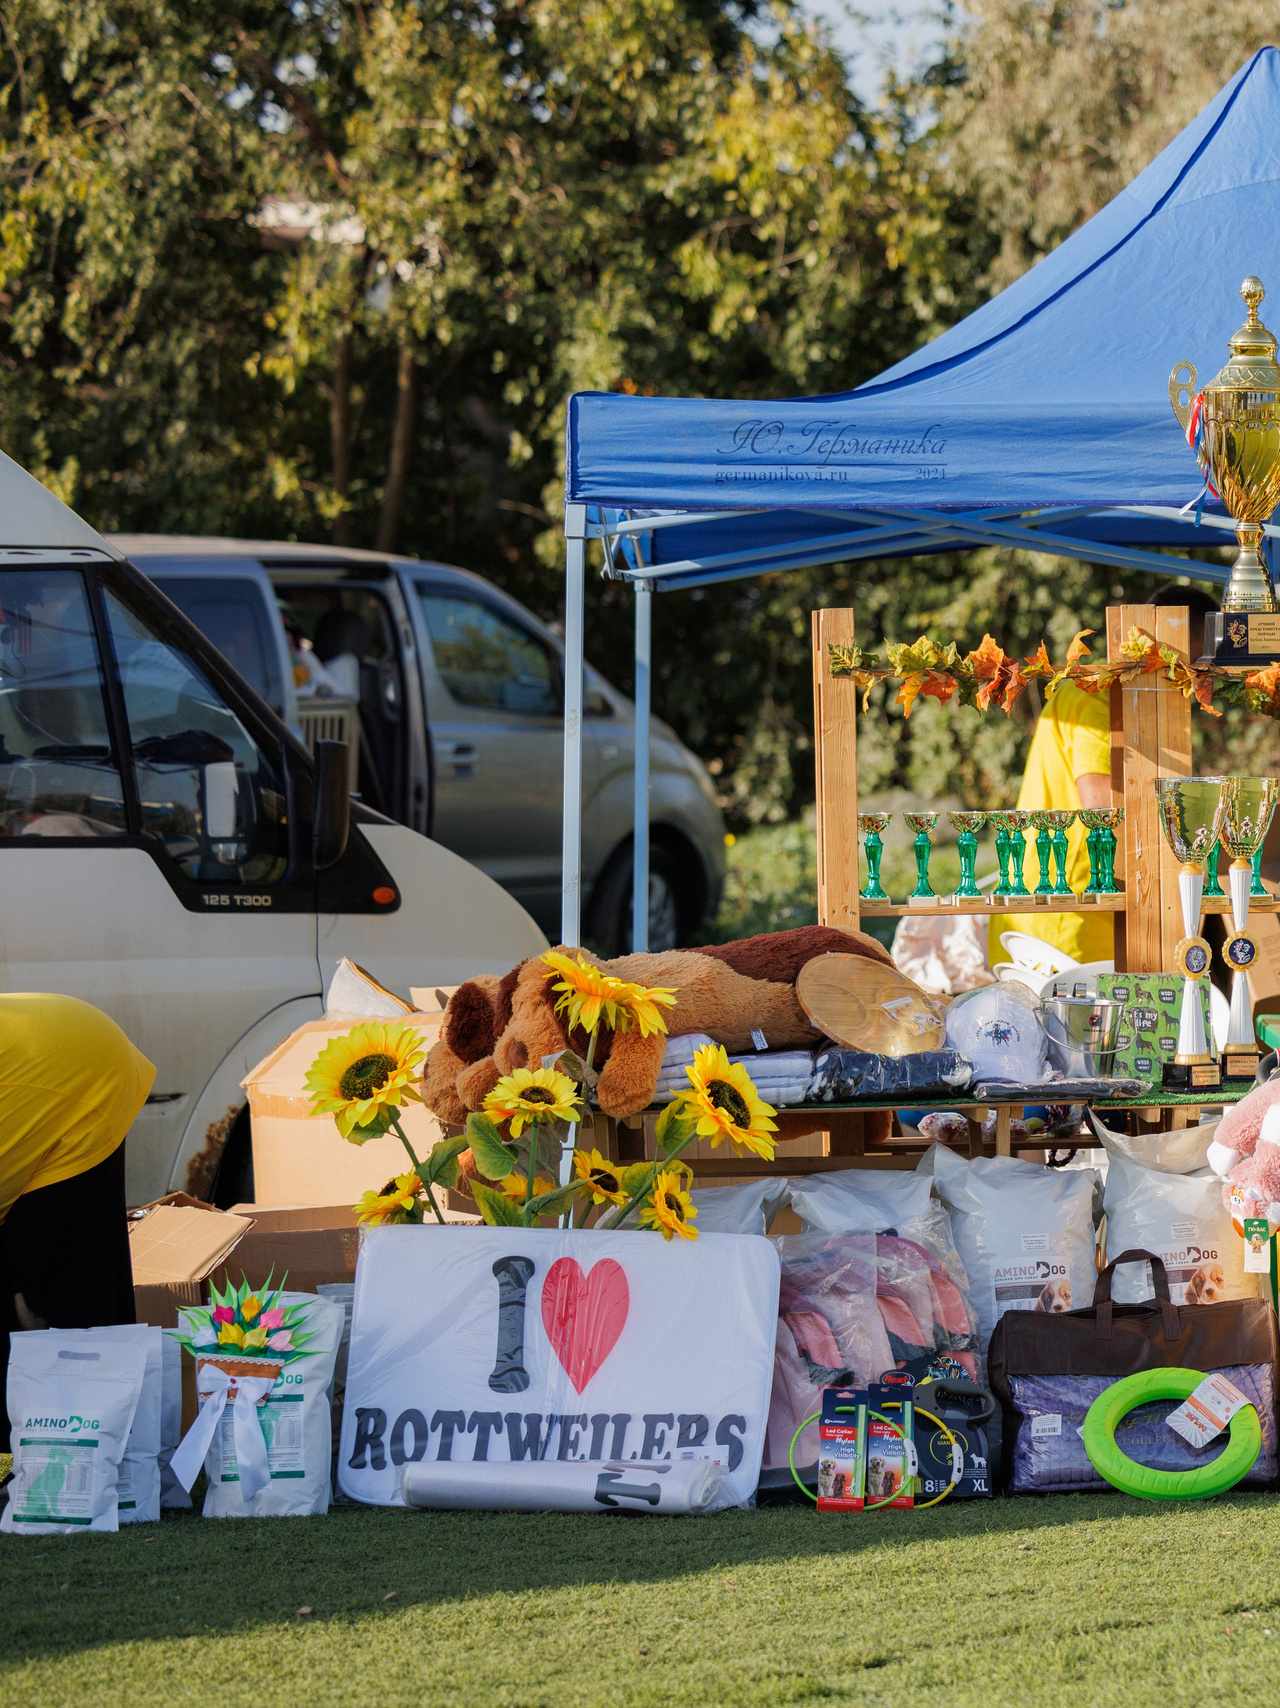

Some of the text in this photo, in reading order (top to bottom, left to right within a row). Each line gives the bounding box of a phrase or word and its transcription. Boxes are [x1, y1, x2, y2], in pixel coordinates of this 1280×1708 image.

[202, 895, 272, 906] 125 T300
[1145, 1012, 1158, 1021] my
[1136, 1019, 1152, 1027] life
[488, 1255, 536, 1394] I
[883, 1375, 909, 1384] flexi
[348, 1407, 747, 1472] ROTTWEILERS
[835, 1437, 855, 1445] Nylon
[883, 1434, 902, 1442] Nylon
[925, 1480, 935, 1492] 8
[973, 1479, 988, 1492] XL
